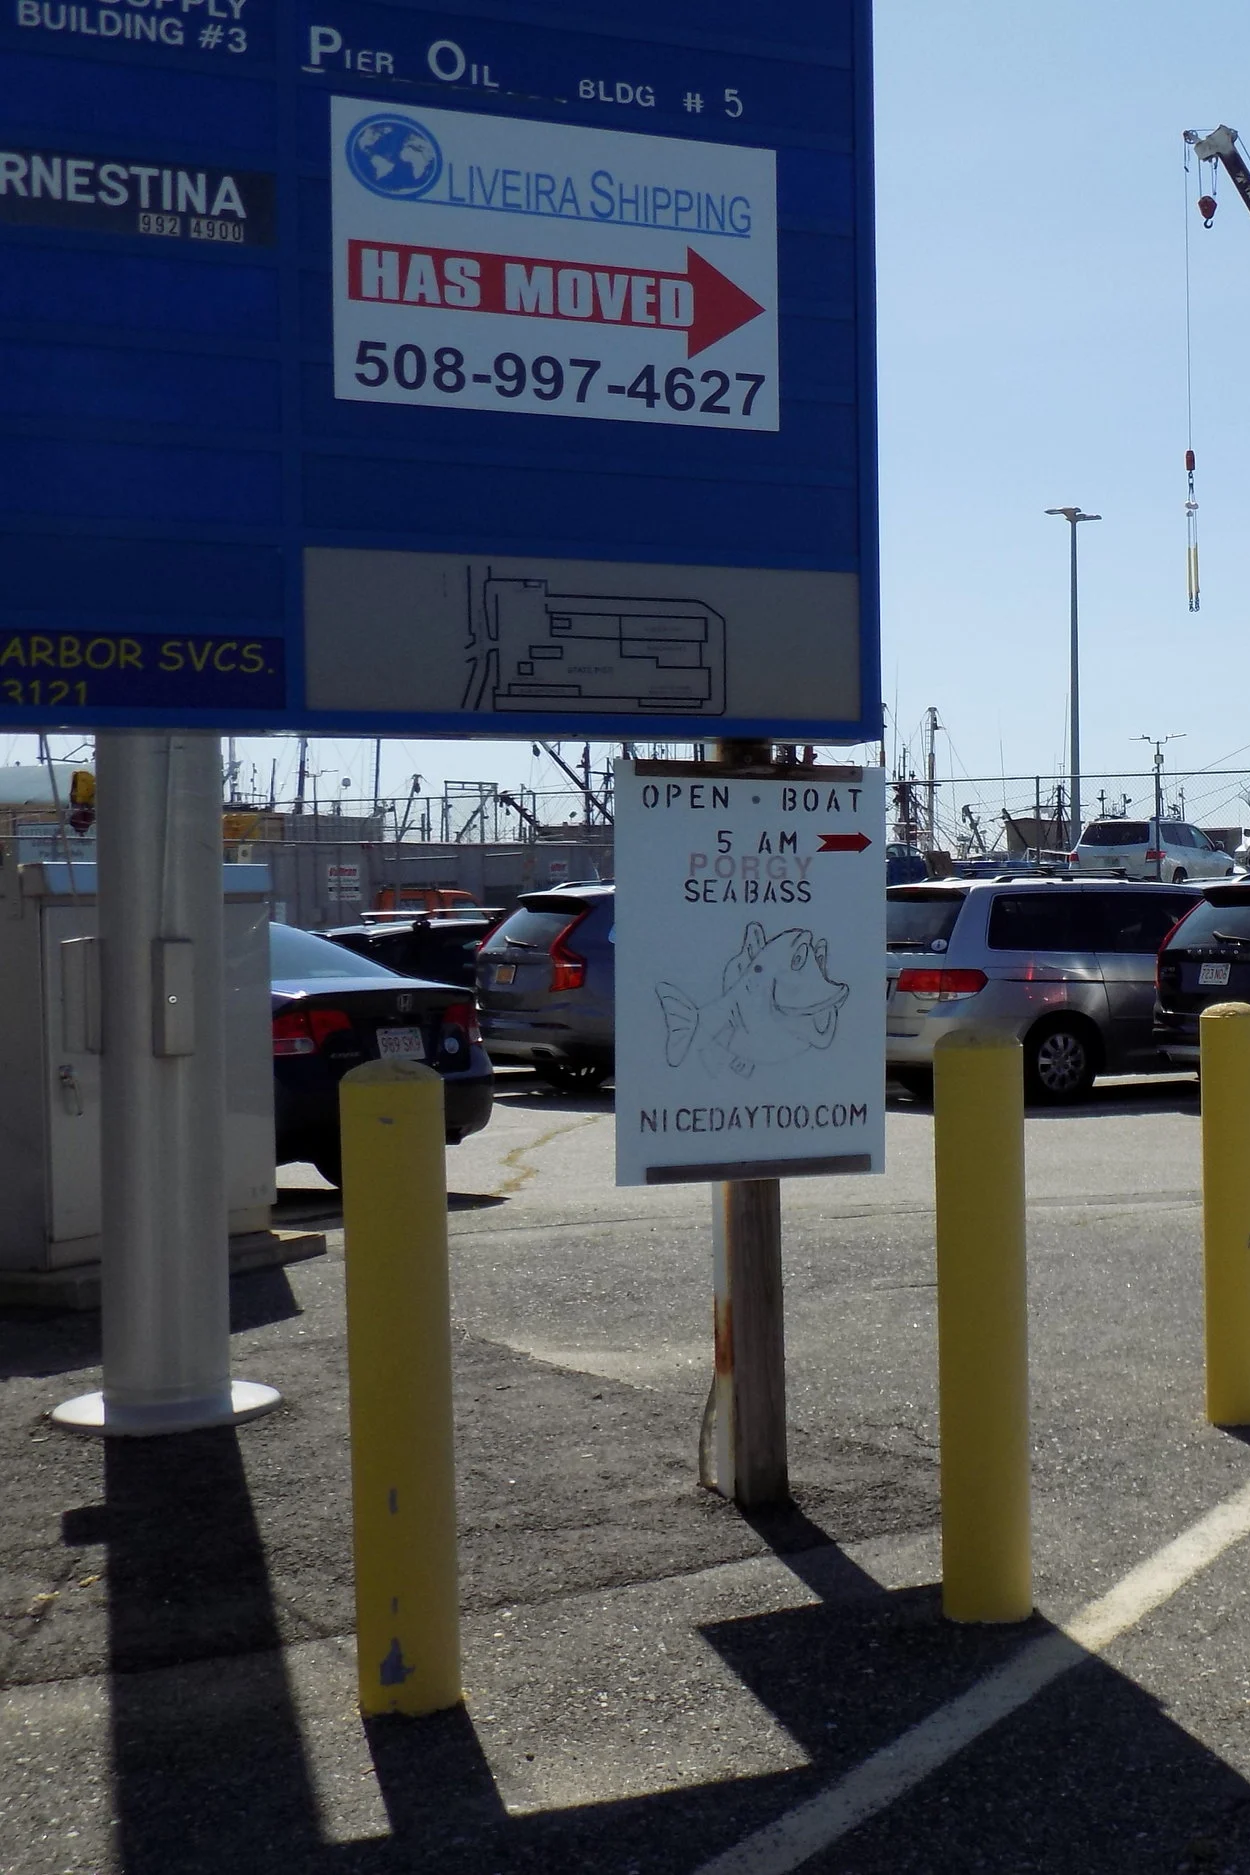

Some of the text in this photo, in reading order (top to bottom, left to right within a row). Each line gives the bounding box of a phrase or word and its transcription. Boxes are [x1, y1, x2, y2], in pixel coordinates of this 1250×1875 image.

[17, 0, 248, 53] BUILDING #3
[309, 25, 394, 75] PIER
[427, 40, 499, 88] OIL
[578, 79, 656, 108] BLDG
[724, 89, 744, 118] 5
[0, 153, 247, 218] RNESTINA
[589, 169, 752, 234] SHIPPING
[141, 215, 243, 241] 992 4900
[360, 248, 695, 327] HAS MOVED
[354, 340, 767, 416] 508-997-4627
[0, 636, 275, 673] ARBOR SVCS.
[642, 784, 863, 813] OPEN BOAT
[690, 853, 813, 880] PORGY
[717, 830, 797, 854] 5 AM
